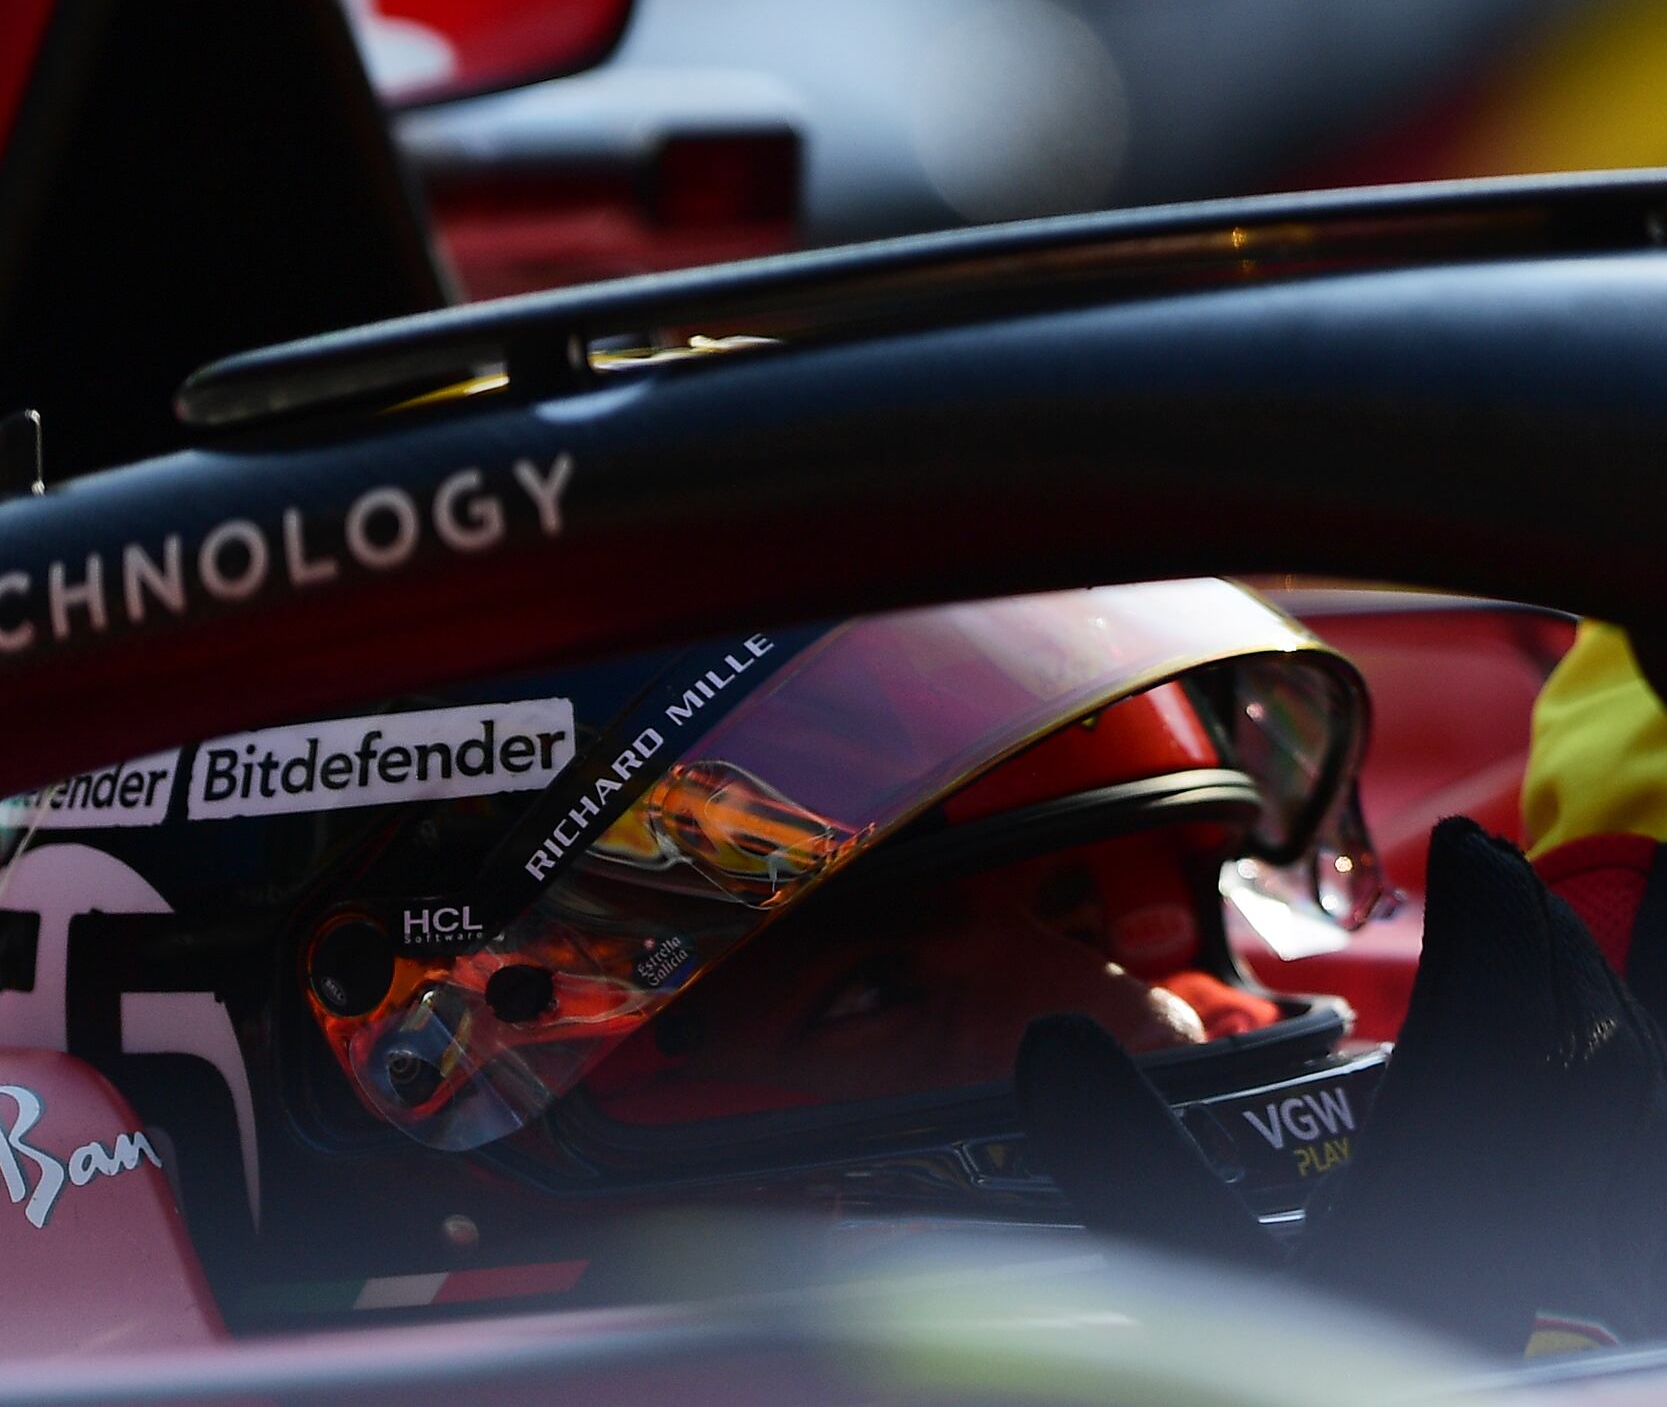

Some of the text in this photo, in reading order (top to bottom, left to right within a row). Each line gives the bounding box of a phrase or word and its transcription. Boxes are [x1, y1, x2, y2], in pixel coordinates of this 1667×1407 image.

[202, 716, 566, 804] Bitdefender
[524, 631, 775, 882] RICHARD MILLE
[403, 906, 483, 934] HCL
[403, 931, 484, 945] Software
[637, 936, 682, 978] Estrella
[648, 947, 690, 987] Galicia
[1241, 1087, 1355, 1150] VGW
[1293, 1137, 1350, 1177] PLAY
